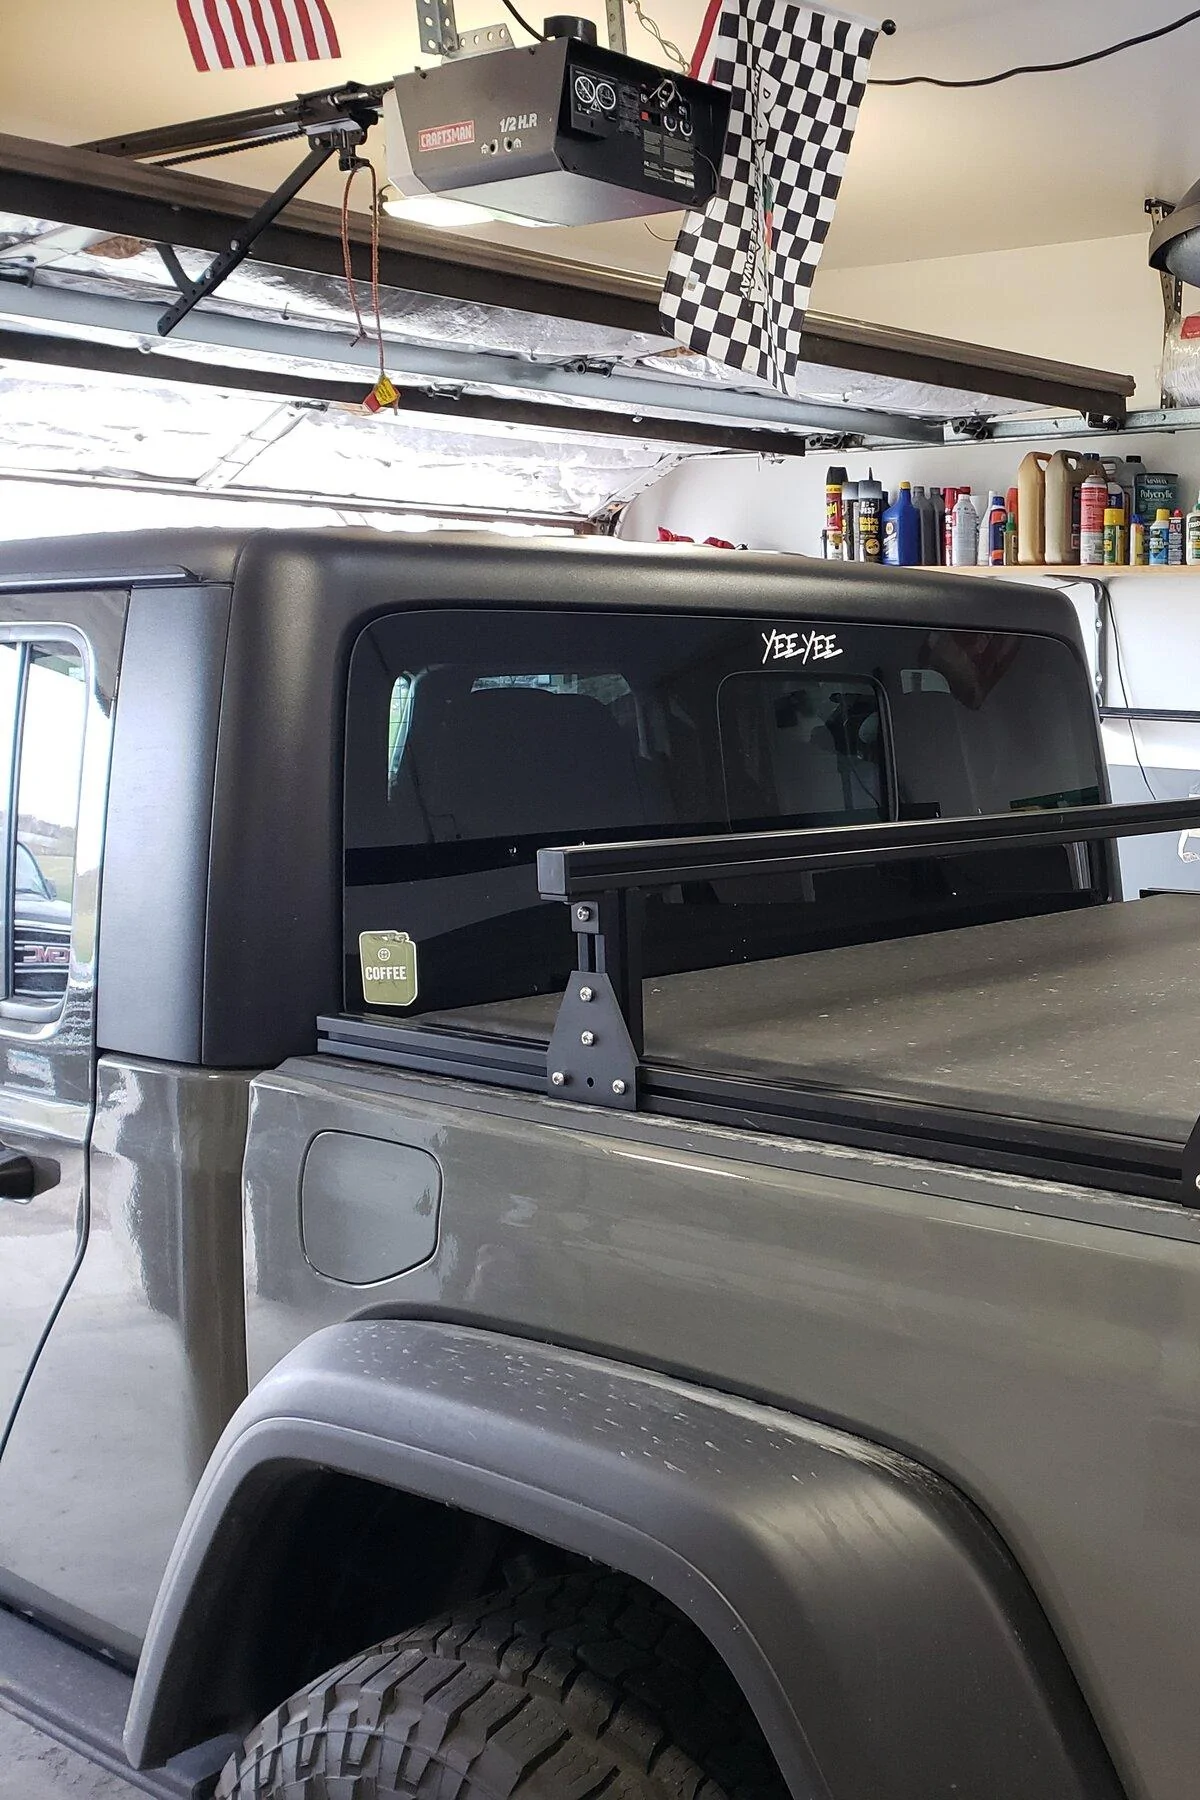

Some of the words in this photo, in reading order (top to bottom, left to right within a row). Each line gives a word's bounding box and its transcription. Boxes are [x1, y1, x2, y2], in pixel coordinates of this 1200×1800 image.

[500, 116, 517, 133] 1/2
[421, 124, 472, 148] CRAFTSMAN
[1140, 489, 1173, 499] Polycrylic
[761, 629, 805, 664] YEE
[801, 630, 843, 665] YEE
[365, 966, 407, 980] COFFEE
